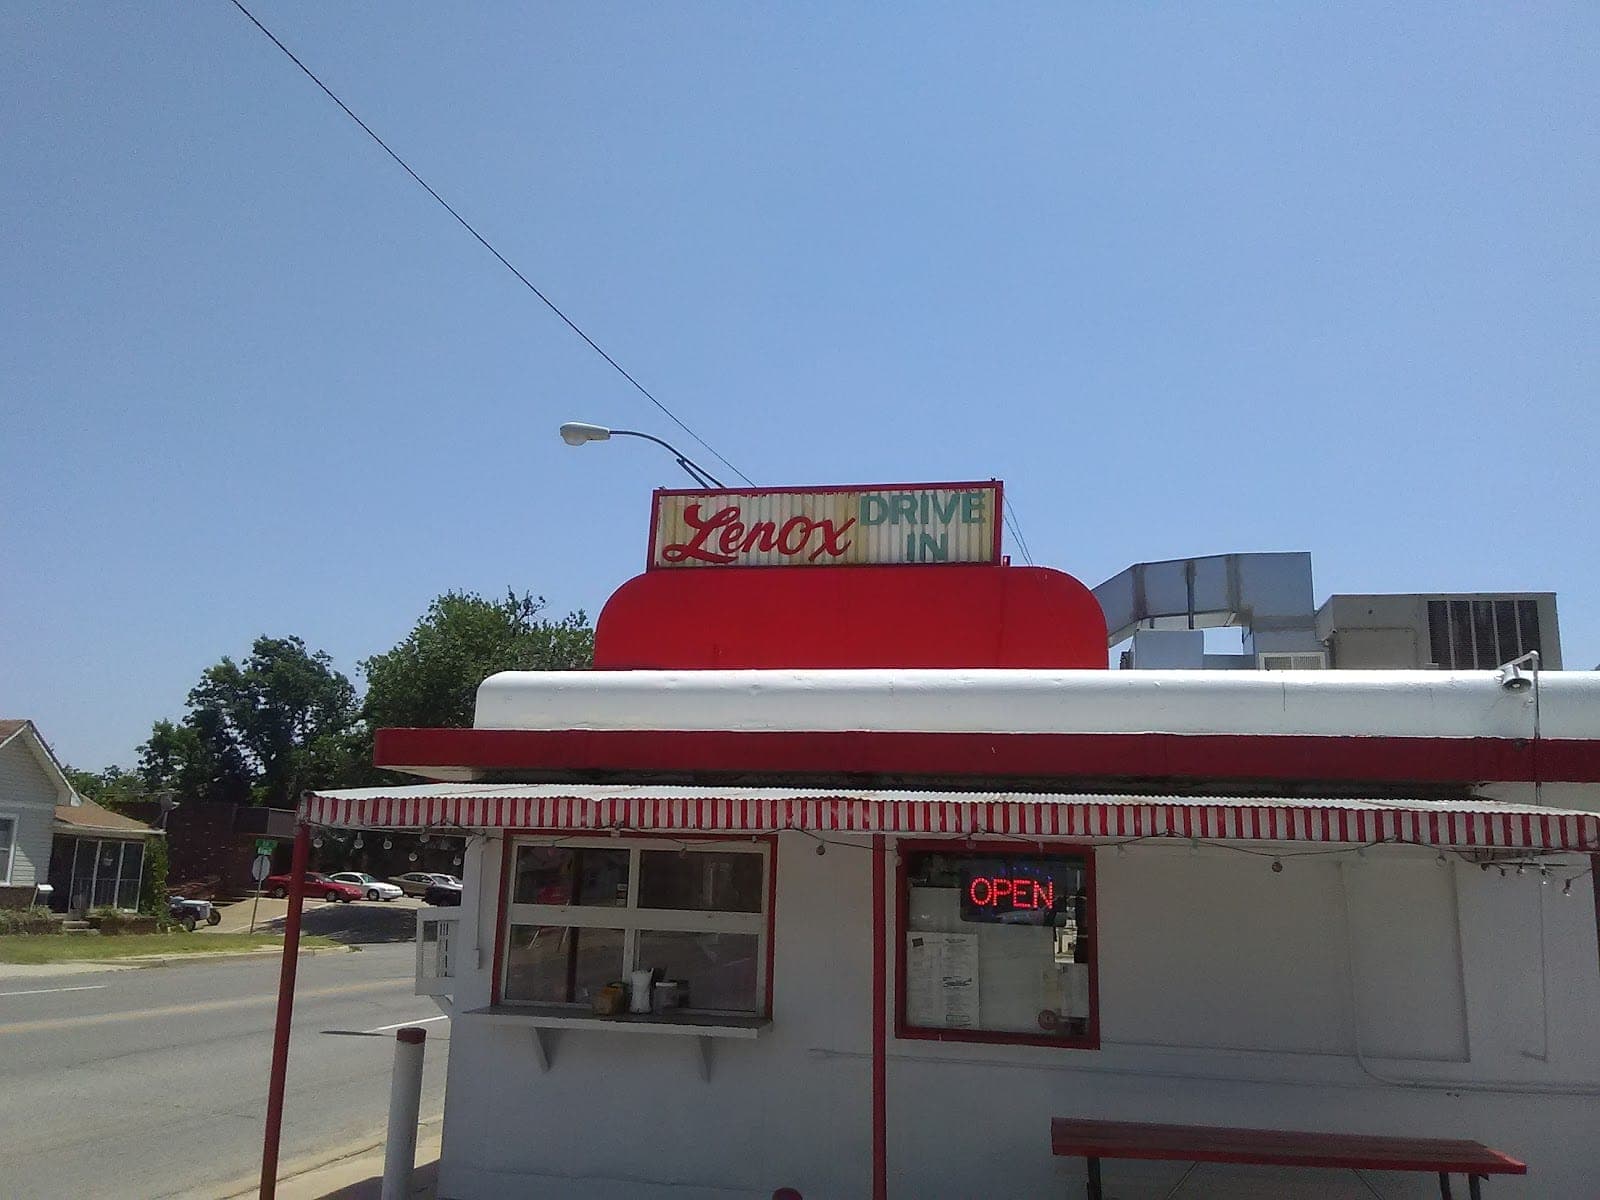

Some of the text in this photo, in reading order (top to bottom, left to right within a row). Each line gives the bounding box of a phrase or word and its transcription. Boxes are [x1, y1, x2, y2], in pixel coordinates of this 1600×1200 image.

[859, 493, 986, 526] DRIVE
[663, 505, 855, 564] Lenox
[906, 533, 948, 562] IN
[970, 878, 1054, 909] OPEN
